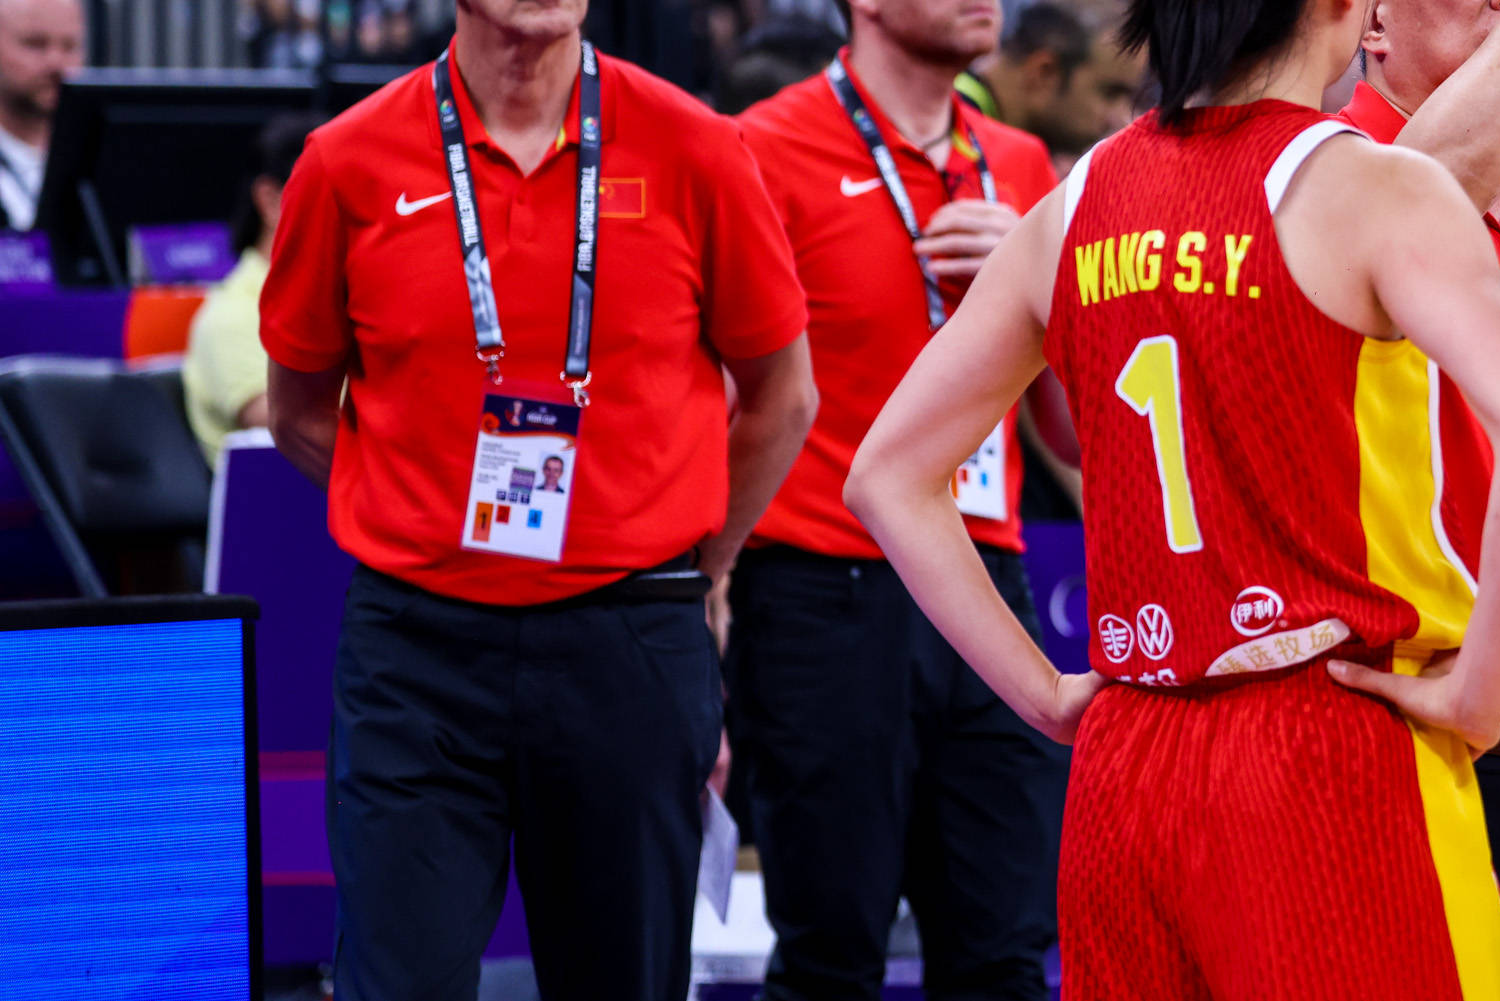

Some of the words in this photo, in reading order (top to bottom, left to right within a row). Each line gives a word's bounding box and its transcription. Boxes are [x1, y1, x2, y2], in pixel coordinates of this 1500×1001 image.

[1075, 229, 1166, 306] WANG
[1173, 231, 1262, 299] S.Y.
[1115, 334, 1203, 554] 1
[1236, 598, 1275, 624] 伊利
